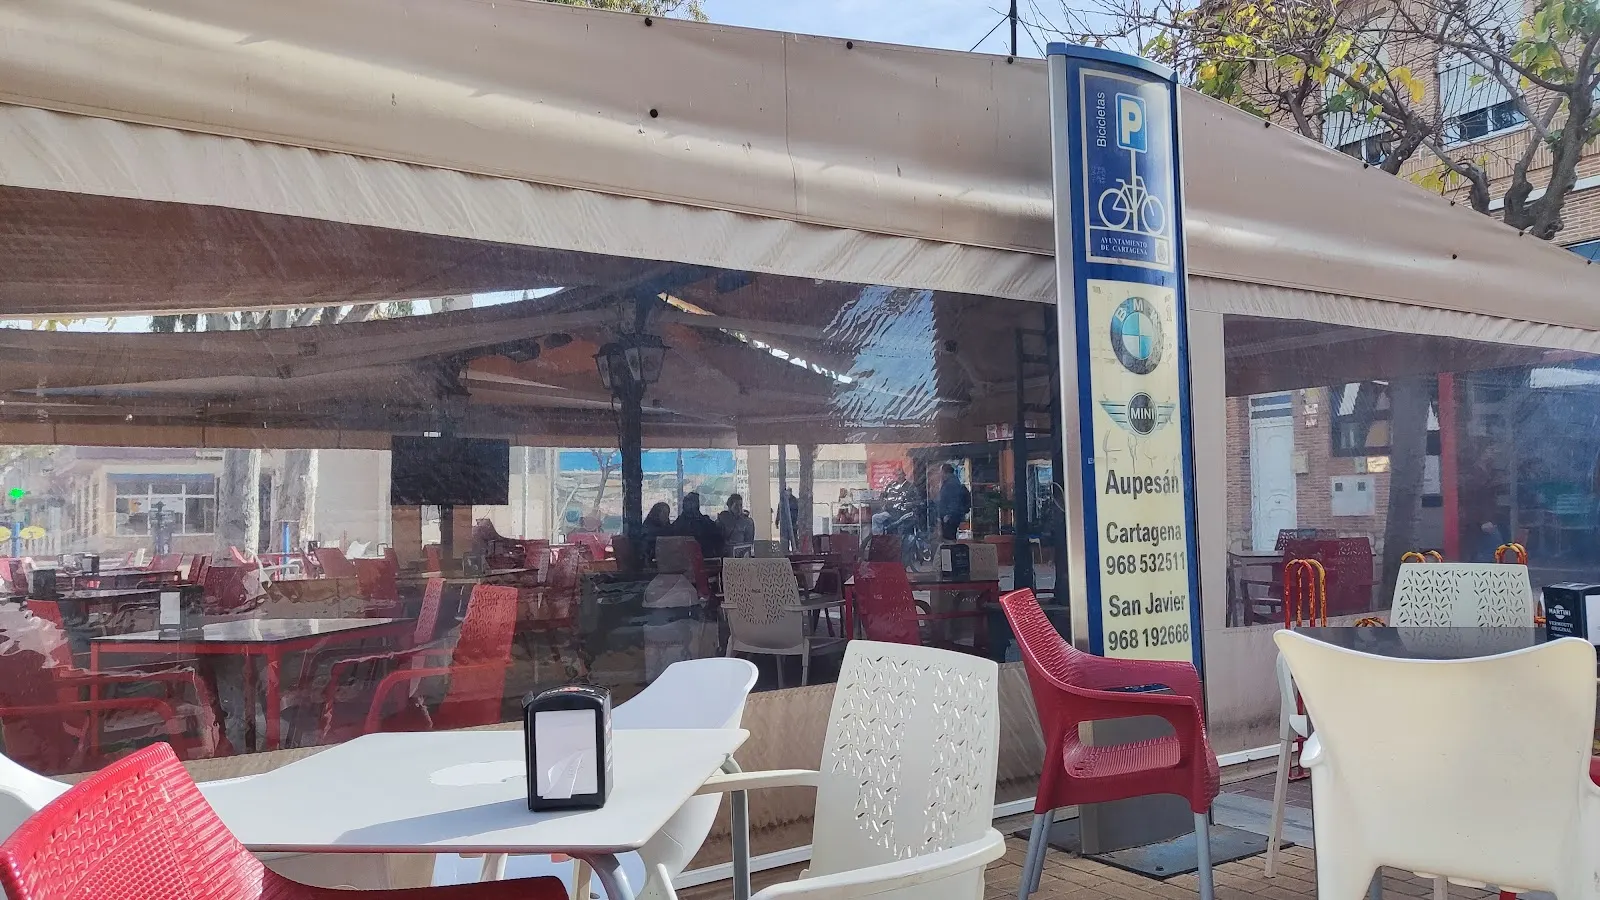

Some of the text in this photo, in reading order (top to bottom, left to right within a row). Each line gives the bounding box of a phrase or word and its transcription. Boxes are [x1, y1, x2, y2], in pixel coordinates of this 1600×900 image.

[1096, 92, 1106, 147] Bicicletas
[1121, 98, 1142, 145] P
[1101, 236, 1148, 248] AYUNTAMIENTO
[1112, 245, 1148, 255] CARTAGENA
[1130, 407, 1155, 420] MINI
[1105, 469, 1179, 499] Aupesán
[1106, 522, 1182, 546] Cartagena
[1106, 552, 1185, 575] 968 532511
[1109, 591, 1186, 617] San Javier
[1548, 608, 1571, 616] MARTINI
[1108, 623, 1189, 651] 968 192668
